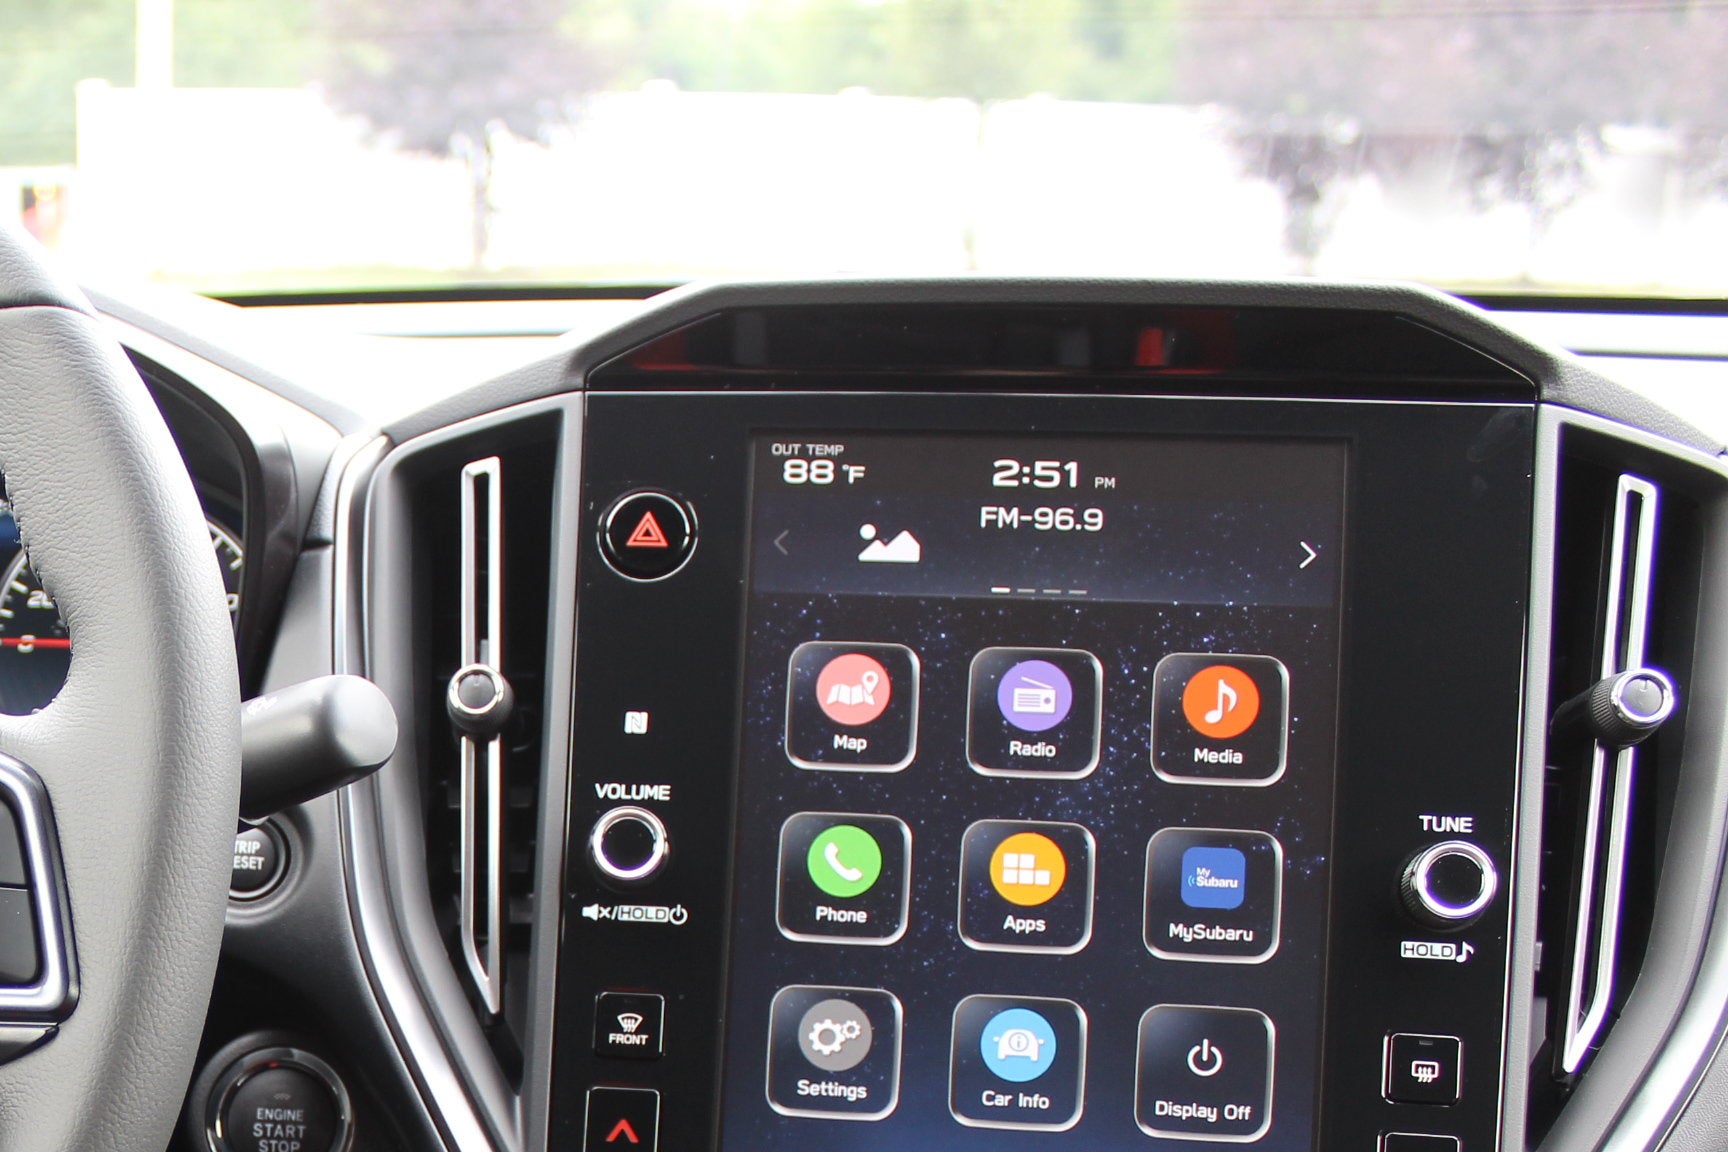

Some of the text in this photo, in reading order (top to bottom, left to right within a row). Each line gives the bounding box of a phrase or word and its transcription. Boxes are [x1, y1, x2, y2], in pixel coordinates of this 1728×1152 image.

[771, 443, 845, 456] OUT TEMP
[783, 459, 835, 485] 88
[992, 459, 1116, 489] 2:51 PM
[980, 506, 1104, 532] FM-96.9
[833, 735, 867, 753] Map
[1009, 740, 1056, 758] Radio
[1194, 747, 1243, 765] Media
[595, 783, 671, 800] VOLUME
[1419, 815, 1473, 833] TUNE
[233, 855, 264, 870] ESET
[1196, 867, 1210, 877] My
[1196, 876, 1238, 888] Subaru
[816, 906, 867, 924] Phone
[1003, 915, 1046, 936] Apps
[1169, 922, 1253, 942] MySubaru
[1403, 944, 1454, 958] HOLD
[608, 1033, 649, 1045] FRONT
[797, 1078, 868, 1101] Settings
[981, 1090, 1050, 1110] Car Info
[257, 1108, 304, 1122] ENGINE
[1154, 1100, 1251, 1123] Display Off
[253, 1123, 306, 1139] START
